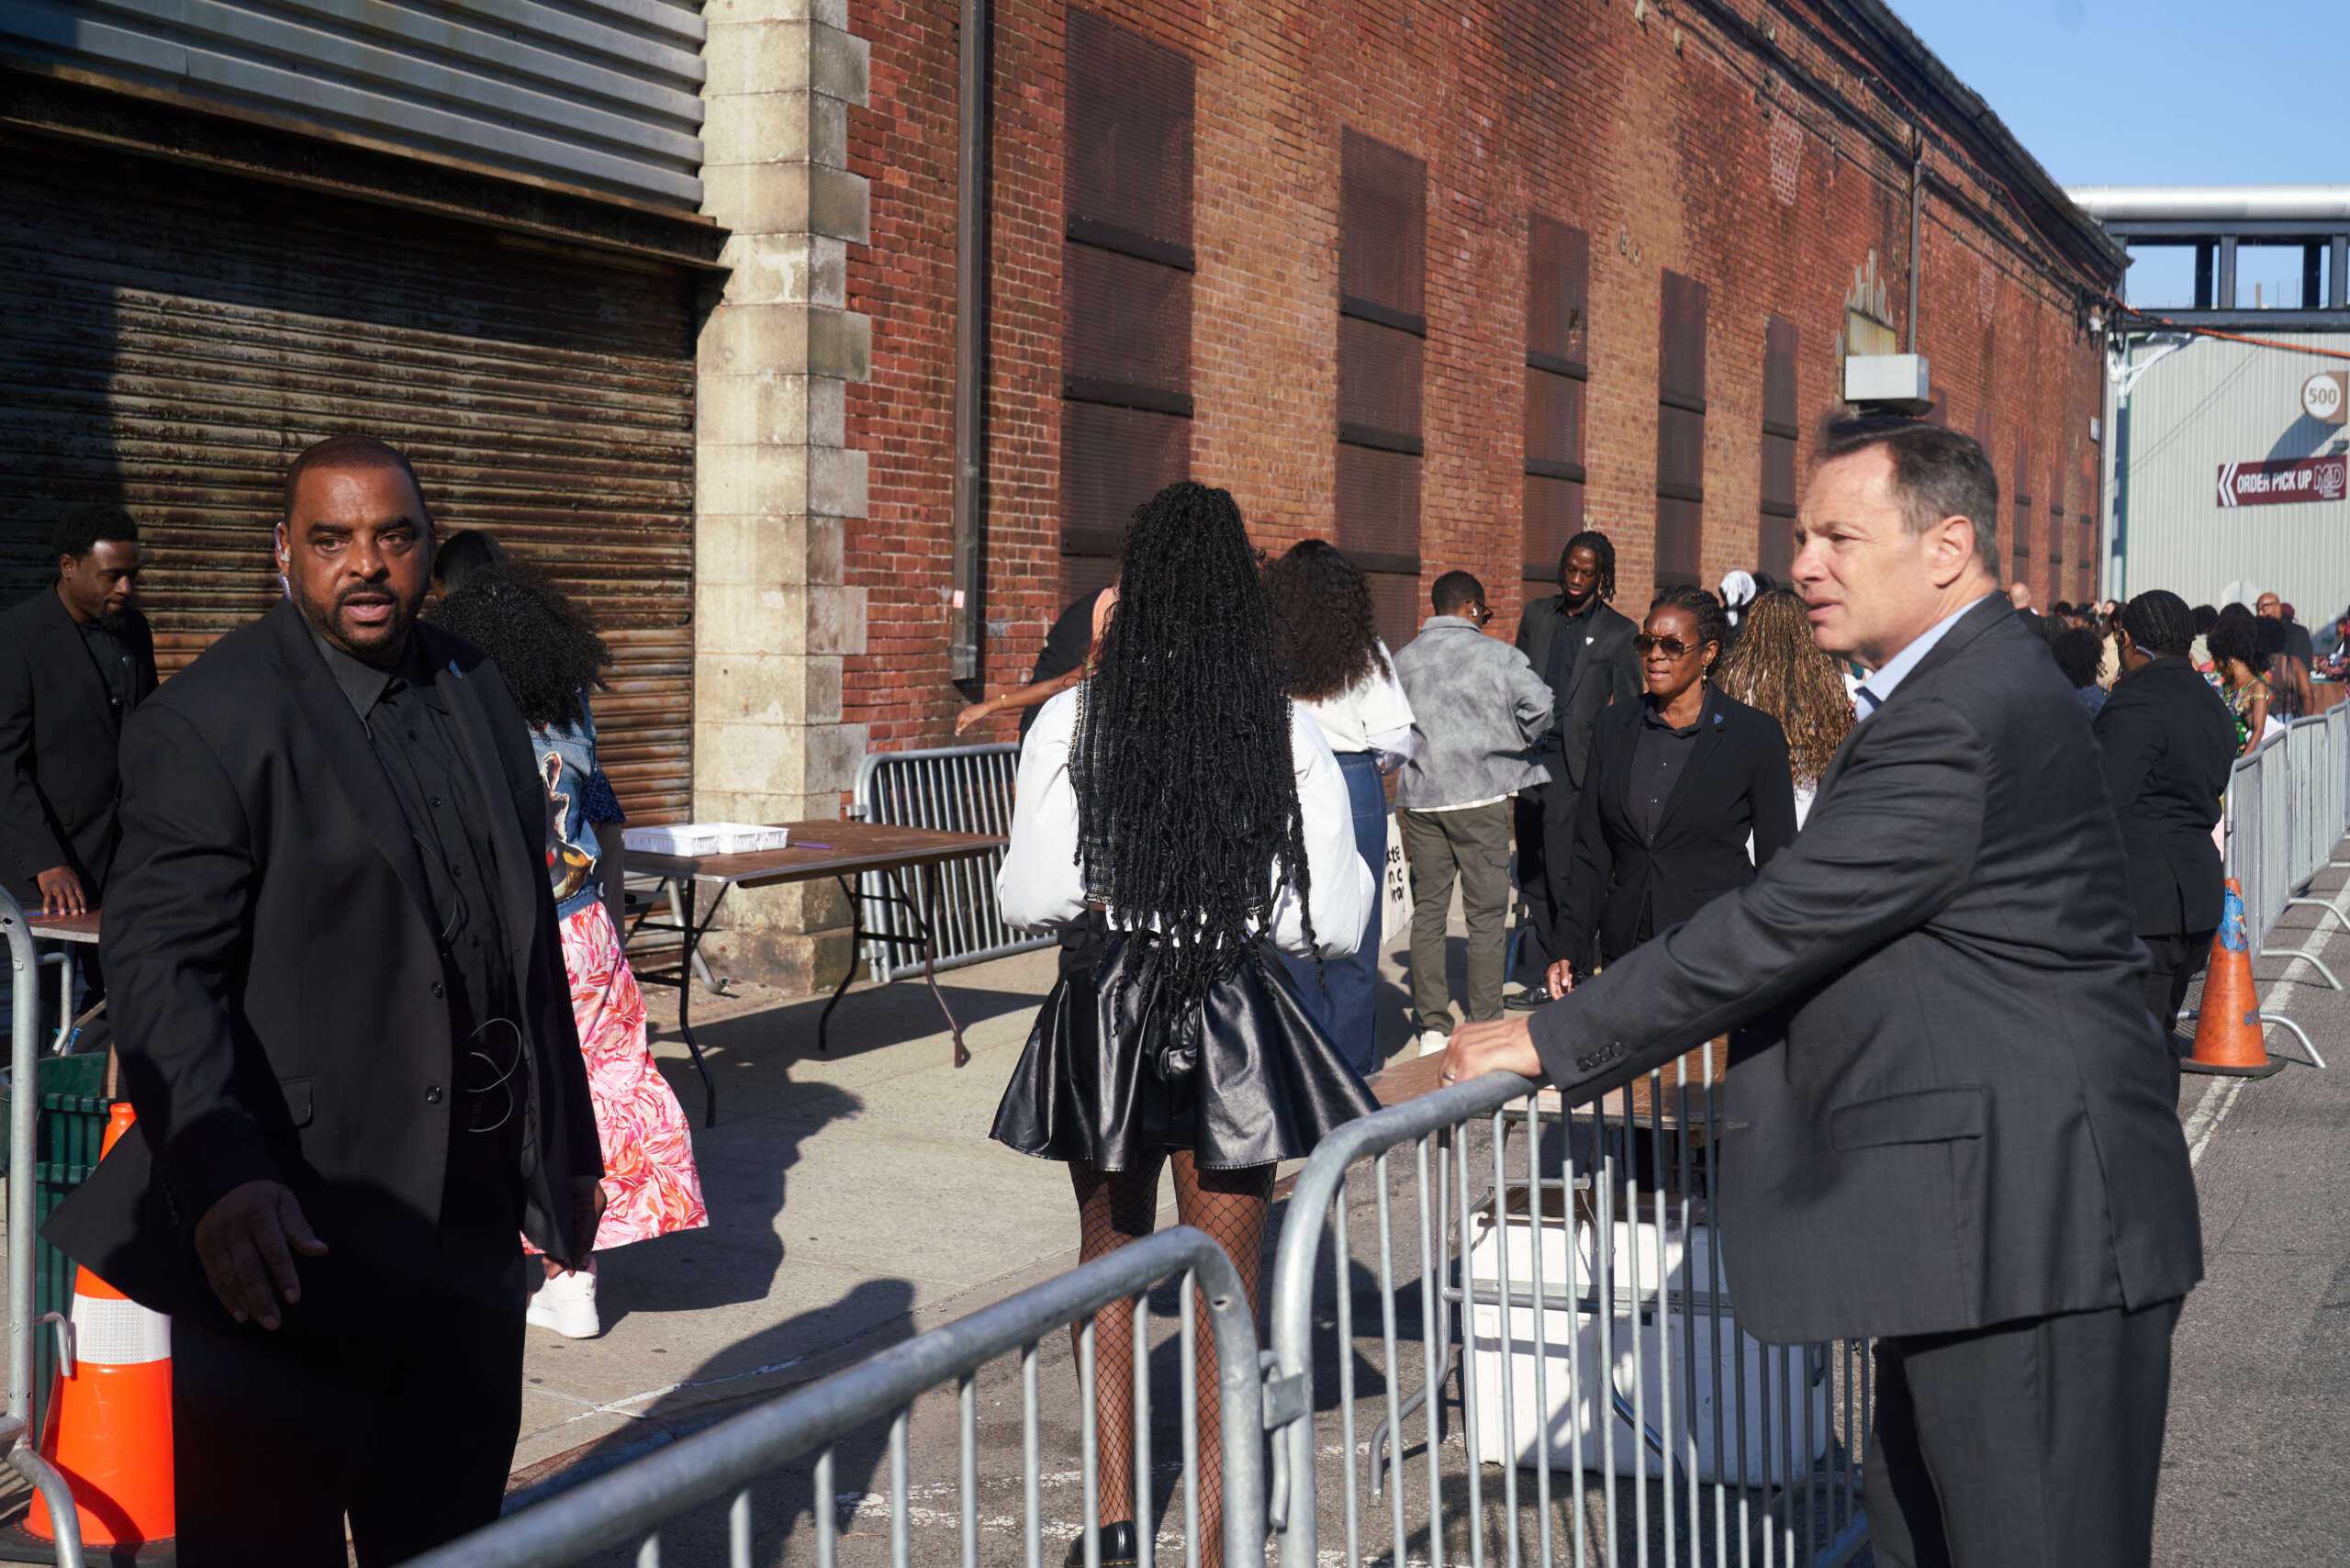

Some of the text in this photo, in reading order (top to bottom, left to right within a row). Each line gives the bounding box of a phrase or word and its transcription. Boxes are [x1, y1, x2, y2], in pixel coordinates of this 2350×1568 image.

[2309, 387, 2337, 405] 500
[2237, 469, 2312, 494] ORDER PICK UP
